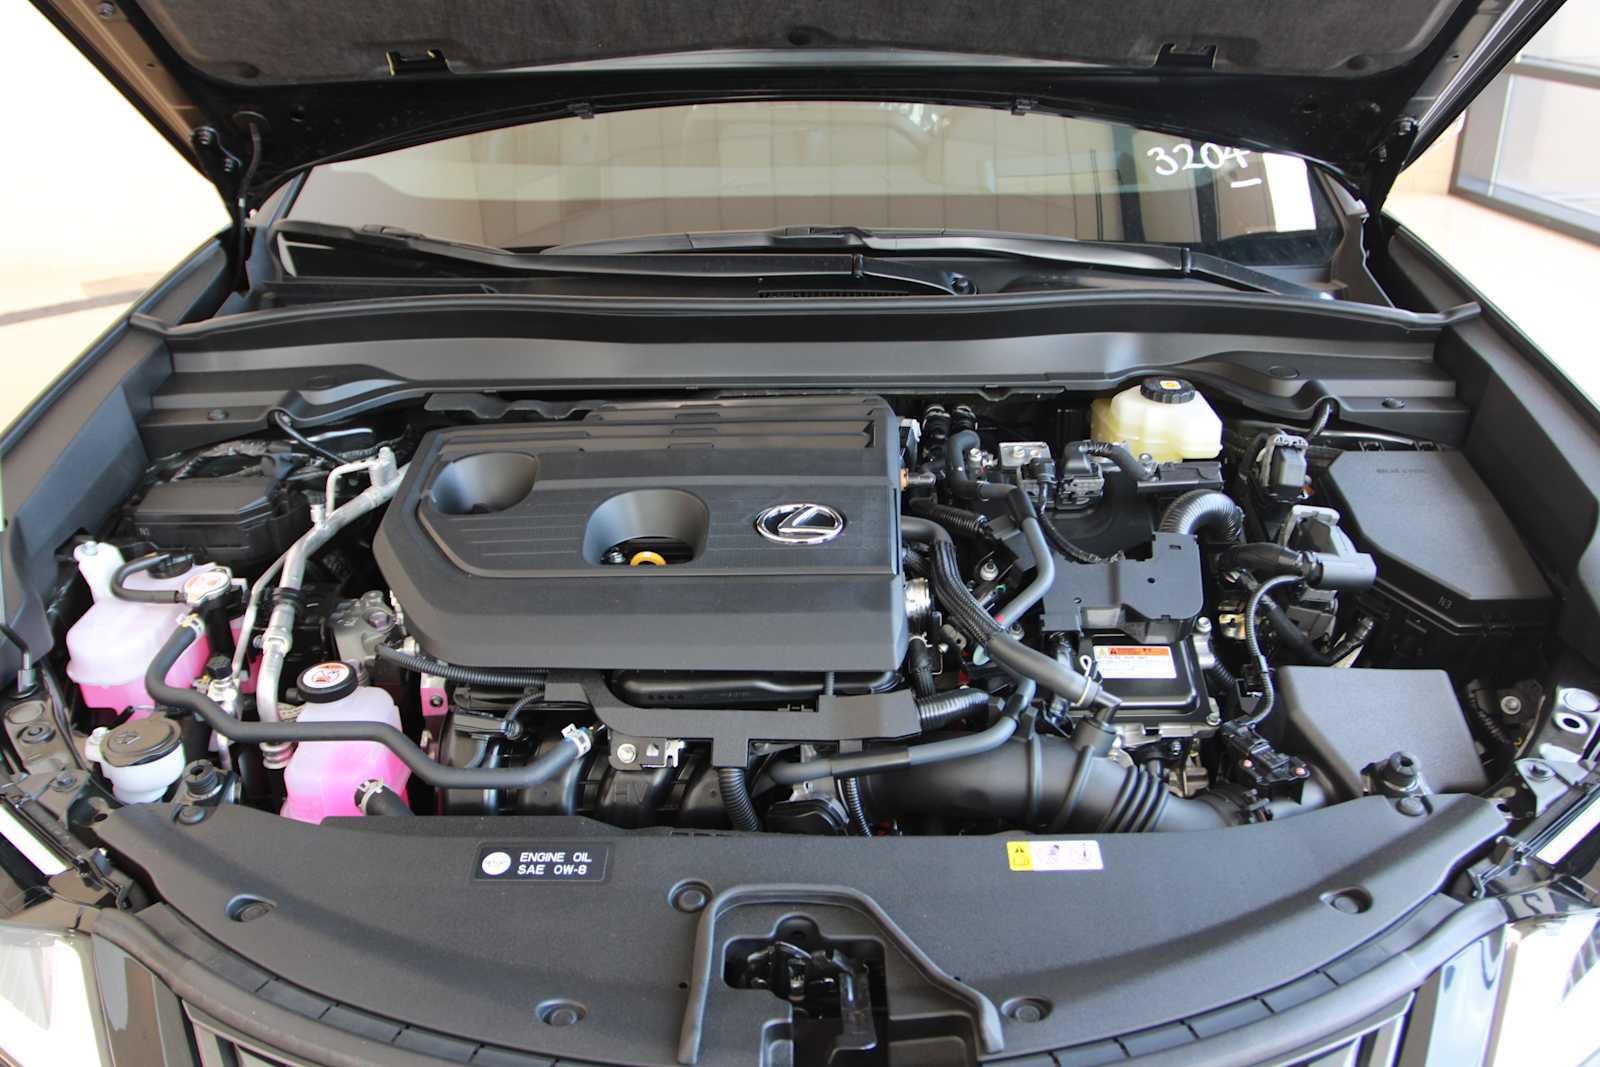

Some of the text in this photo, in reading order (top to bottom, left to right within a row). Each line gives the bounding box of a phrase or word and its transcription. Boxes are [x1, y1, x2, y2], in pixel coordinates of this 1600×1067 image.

[1147, 142, 1251, 175] 3204
[519, 852, 593, 863] ENGINE OIL
[517, 864, 587, 875] SAE 0W-8
